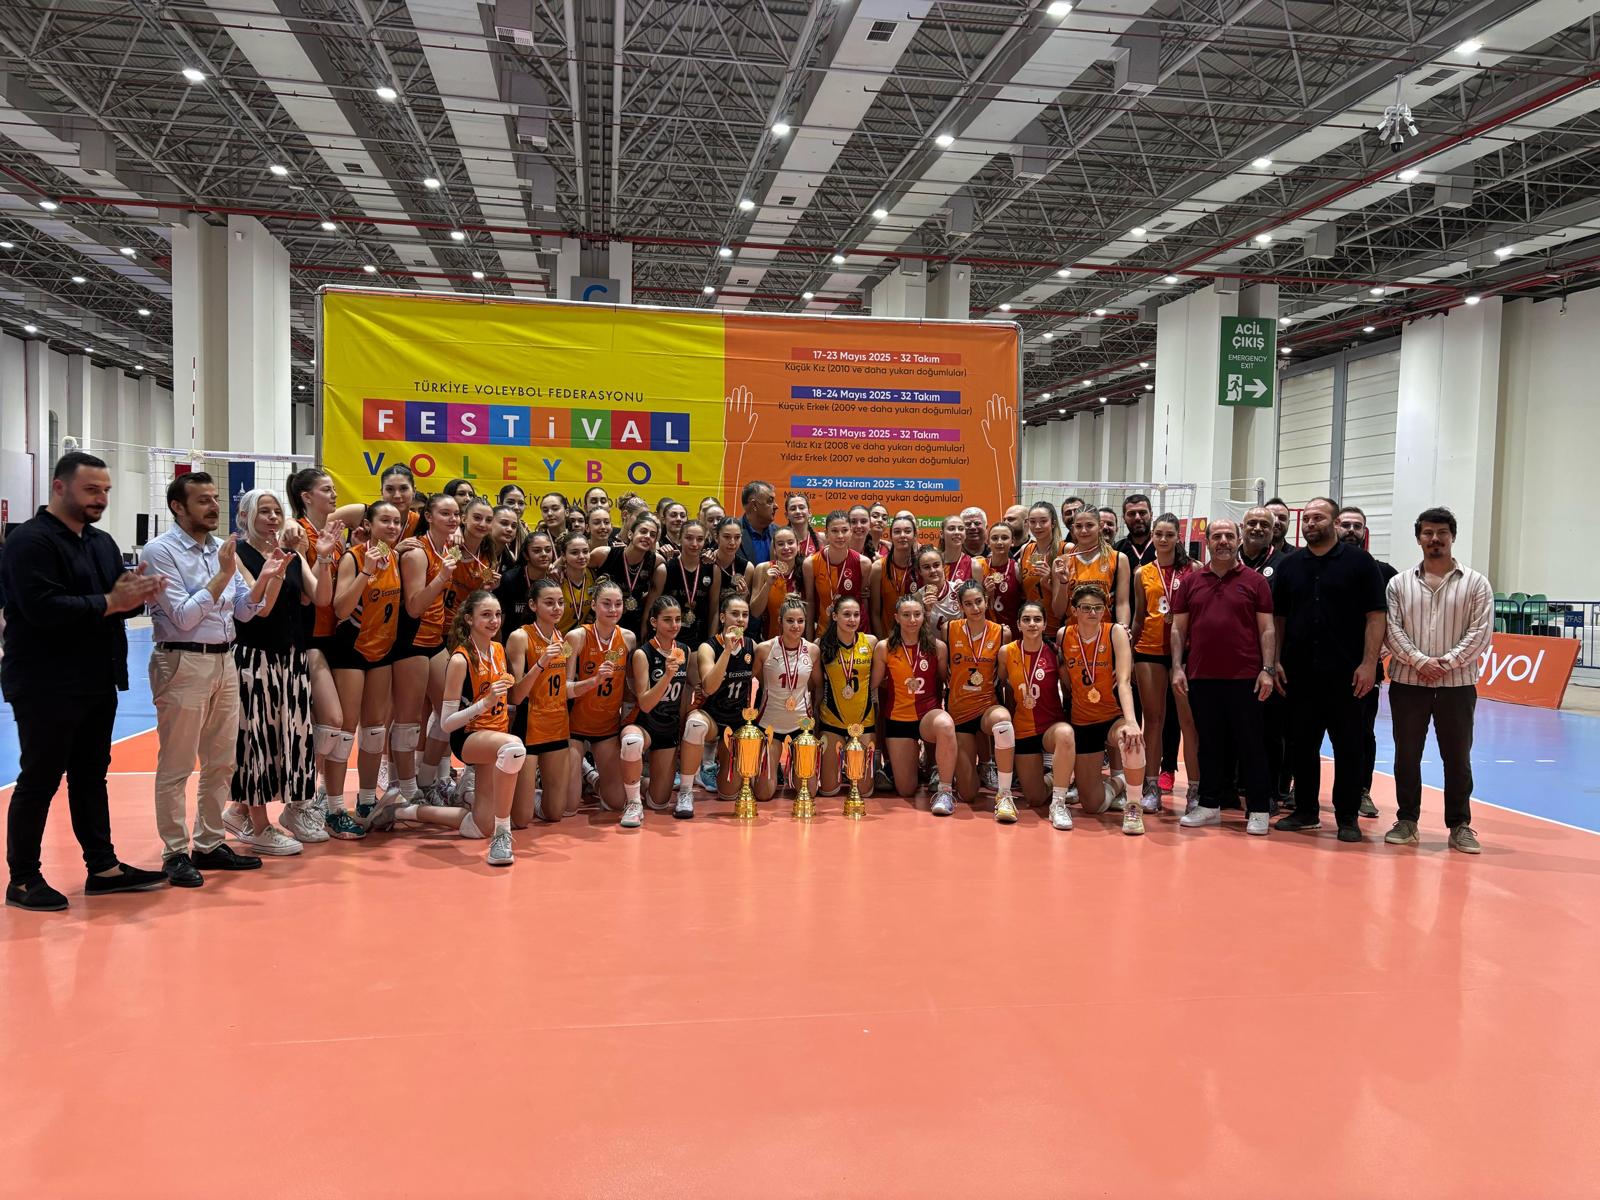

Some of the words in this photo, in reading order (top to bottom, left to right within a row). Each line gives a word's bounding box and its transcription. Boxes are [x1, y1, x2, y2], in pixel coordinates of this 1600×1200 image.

[1235, 321, 1263, 335] ACİL
[1232, 336, 1265, 350] ÇIKIŞ
[812, 350, 838, 360] 17-23
[840, 351, 867, 363] Mayıs
[868, 352, 891, 362] 2025
[900, 353, 911, 363] 32
[913, 354, 940, 364] Takım
[1228, 354, 1268, 362] EMERGENCY
[785, 362, 811, 373] Küçük
[813, 364, 826, 373] Kız
[827, 364, 850, 374] (2010
[852, 366, 862, 374] ve
[864, 365, 887, 375] daha
[889, 366, 915, 377] yukarı
[917, 367, 967, 378] doğumlular)
[414, 379, 469, 394] TÜRKİYE
[474, 384, 543, 398] VOLEYBOL
[548, 387, 644, 403] FEDERASYONU
[812, 388, 838, 398] 18-24
[840, 389, 867, 400] Mayıs
[869, 390, 892, 400] 2025
[900, 391, 912, 401] 32
[913, 392, 941, 402] Takım
[778, 402, 805, 412] Küçük
[806, 403, 829, 412] Erkek
[831, 403, 855, 413] (2009
[858, 405, 868, 413] ve
[870, 404, 893, 414] daha
[894, 405, 920, 416] yukarı
[922, 406, 973, 416] doğumlular)
[811, 427, 838, 437] 26-31
[840, 428, 867, 439] Mayıs
[868, 429, 891, 439] 2025
[900, 429, 911, 439] 32
[913, 430, 940, 440] Takım
[785, 440, 808, 449] Yıldız
[810, 441, 823, 449] Kız
[824, 441, 849, 451] (2008
[863, 442, 885, 451] daha
[887, 443, 913, 454] yukarı
[914, 444, 965, 454] doğumlular)
[780, 453, 802, 461] Yıldız
[805, 453, 828, 462] Erkek
[829, 454, 853, 463] (2007
[867, 455, 890, 464] daha
[892, 456, 917, 466] yukarı
[919, 456, 970, 466] doğumlular)
[363, 451, 690, 487] VOLEYBOL
[806, 478, 833, 488] 23-29
[835, 479, 871, 489] Haziran
[872, 480, 895, 489] 2025
[904, 480, 915, 489] 32
[917, 480, 944, 490] Takım
[825, 491, 847, 501] (2012
[861, 492, 884, 501] daha
[885, 493, 911, 503] yukarı
[913, 493, 963, 504] doğumlular)
[1479, 645, 1545, 686] dyol
[548, 674, 561, 697] 19
[728, 681, 742, 699] 11
